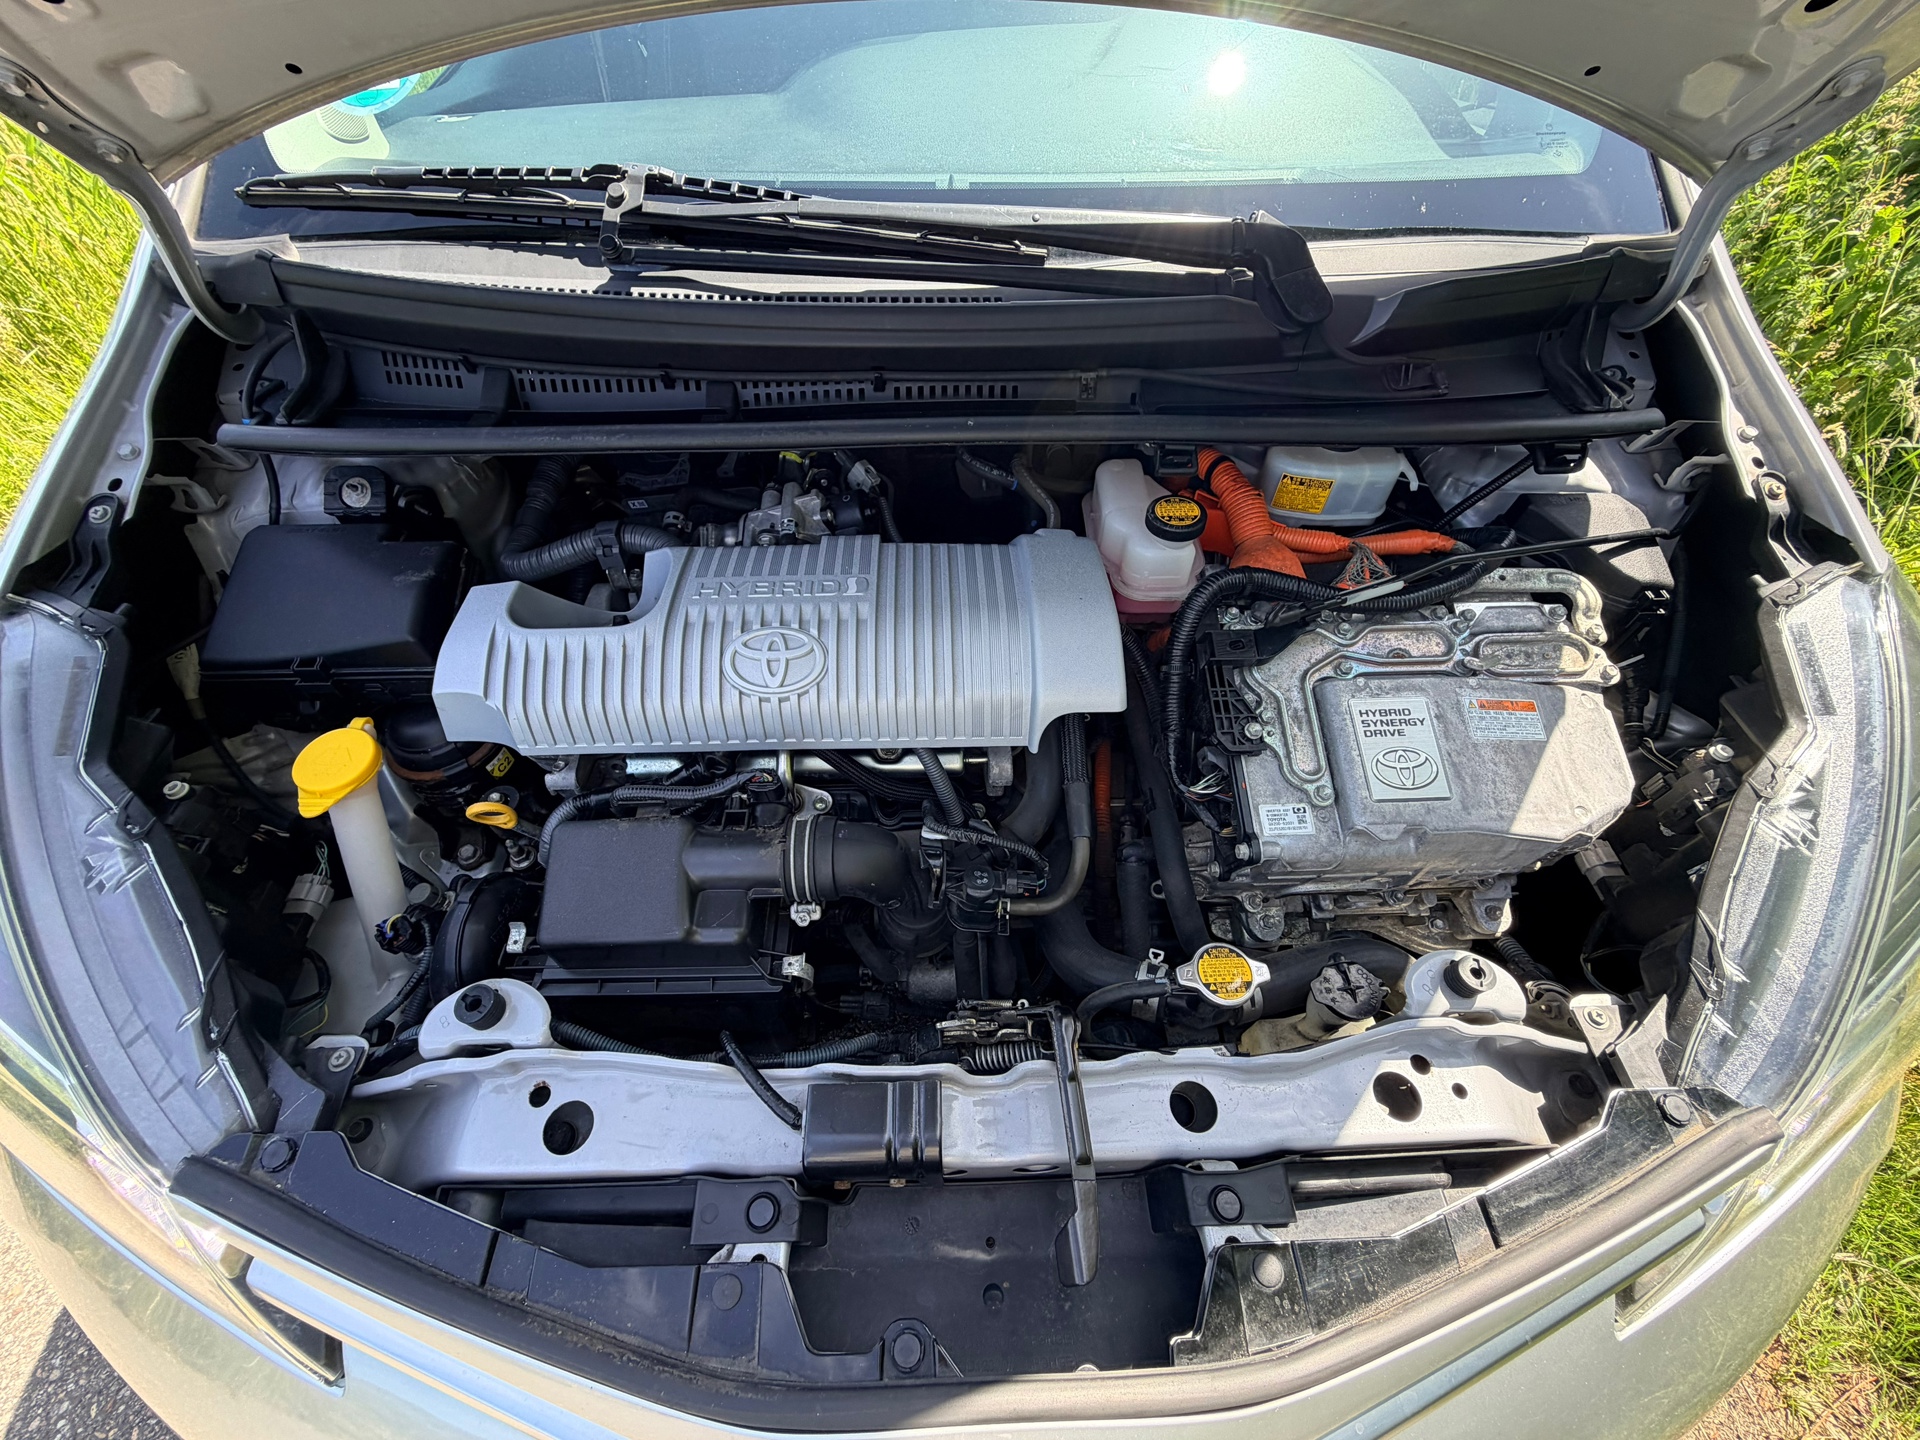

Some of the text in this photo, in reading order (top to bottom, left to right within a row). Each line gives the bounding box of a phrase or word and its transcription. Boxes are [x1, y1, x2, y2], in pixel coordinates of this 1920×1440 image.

[691, 579, 840, 599] HYBRID
[1359, 708, 1412, 717] HYBRID
[1361, 717, 1426, 728] SYNERGY
[1363, 728, 1406, 738] DRIVE
